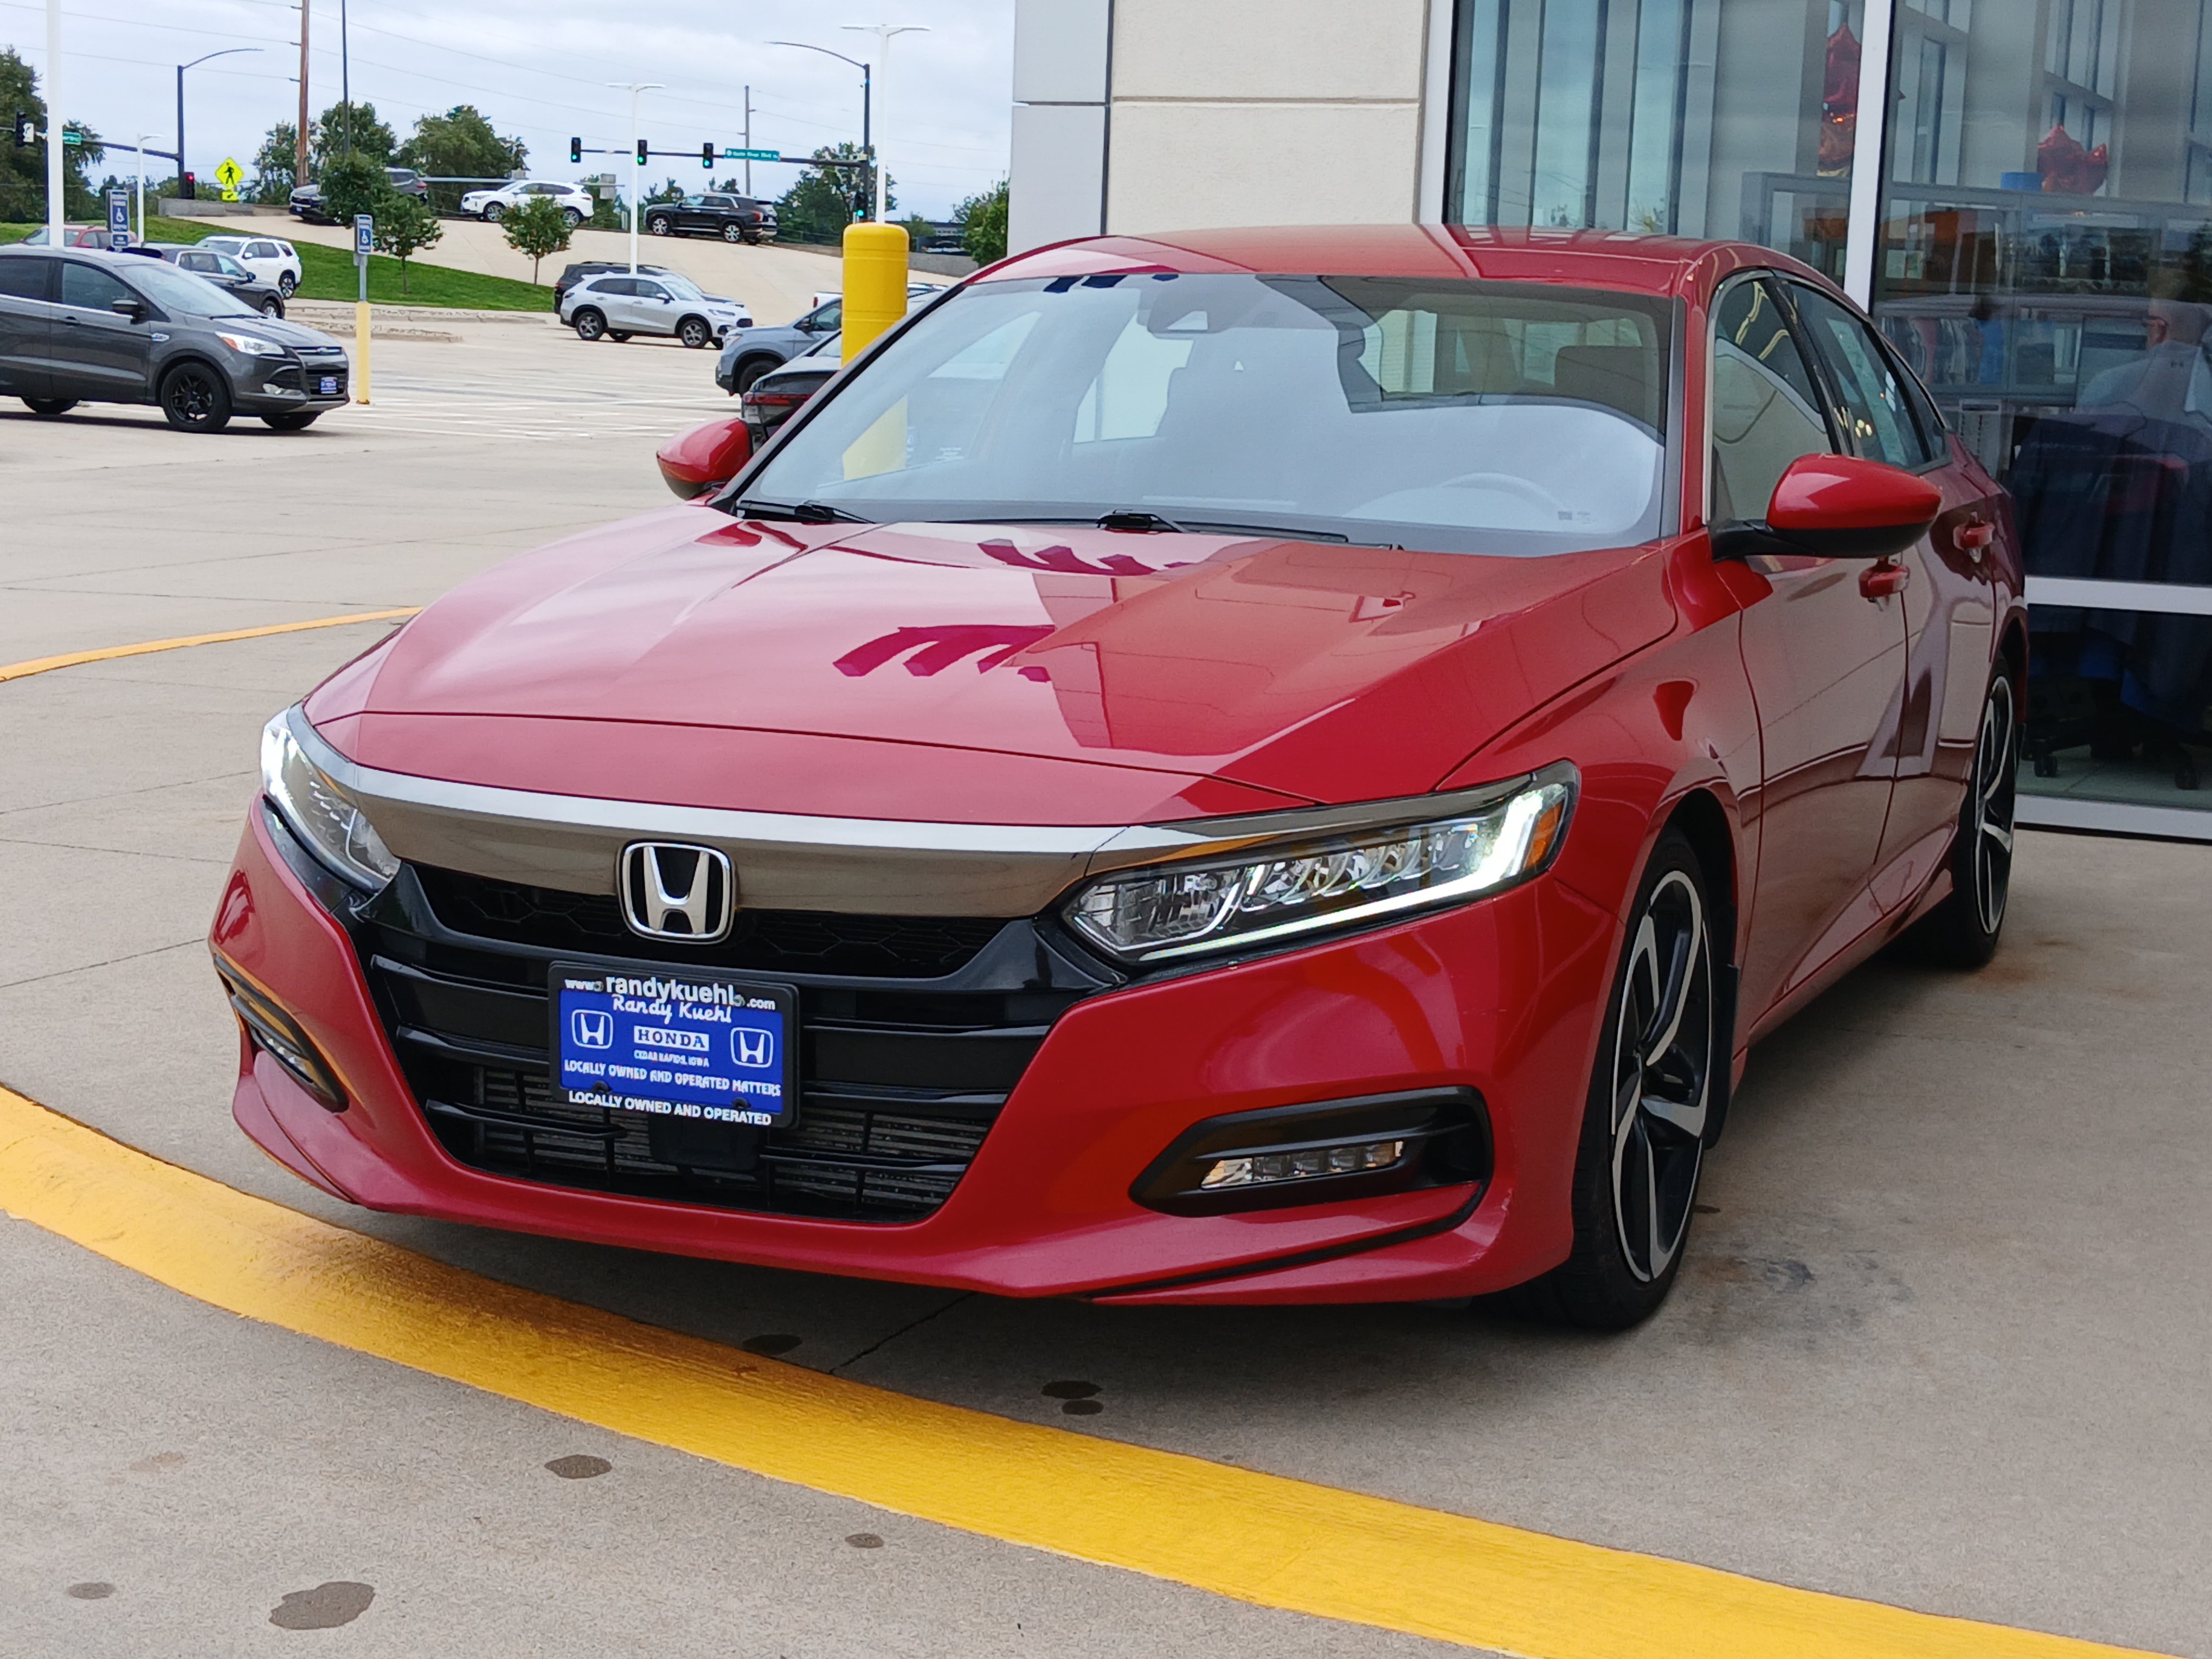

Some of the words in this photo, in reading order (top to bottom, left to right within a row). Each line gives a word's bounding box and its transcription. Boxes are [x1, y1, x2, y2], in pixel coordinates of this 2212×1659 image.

[606, 976, 735, 1006] randykuehl
[747, 998, 775, 1010] .com
[612, 994, 672, 1025] Randy
[679, 1002, 731, 1023] Kuehl
[638, 1029, 705, 1048] HONDA
[564, 1059, 606, 1076] LOCALLY
[608, 1065, 647, 1080] OWNED
[650, 1070, 672, 1083] AND
[674, 1073, 730, 1090] OPERATED
[732, 1079, 781, 1096] MATTERS
[569, 1090, 622, 1108] LOCALLY
[625, 1097, 671, 1114] OWNED
[674, 1103, 701, 1117] AND
[704, 1107, 771, 1126] OPERATED
